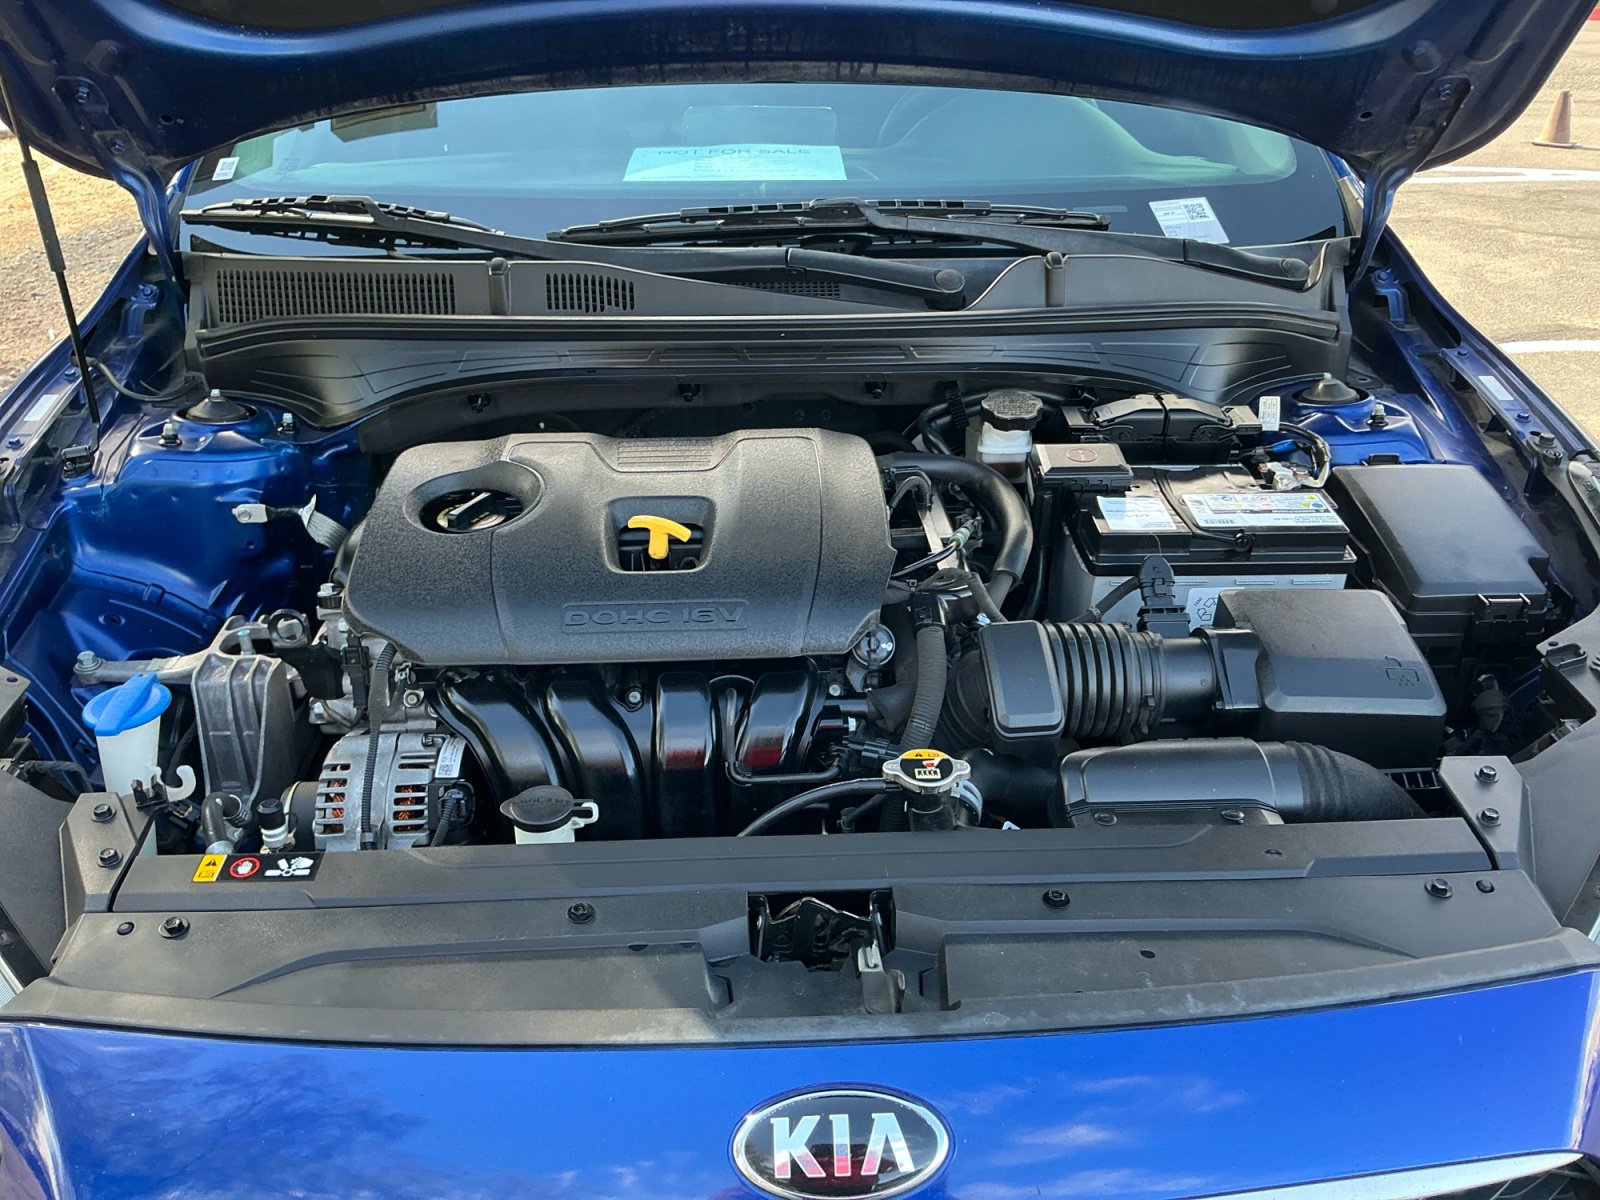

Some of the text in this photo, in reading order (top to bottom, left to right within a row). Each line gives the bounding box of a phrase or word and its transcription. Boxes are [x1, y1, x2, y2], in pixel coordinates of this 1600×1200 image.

[564, 606, 744, 626] DOHC 16V
[770, 1112, 916, 1179] KIA
